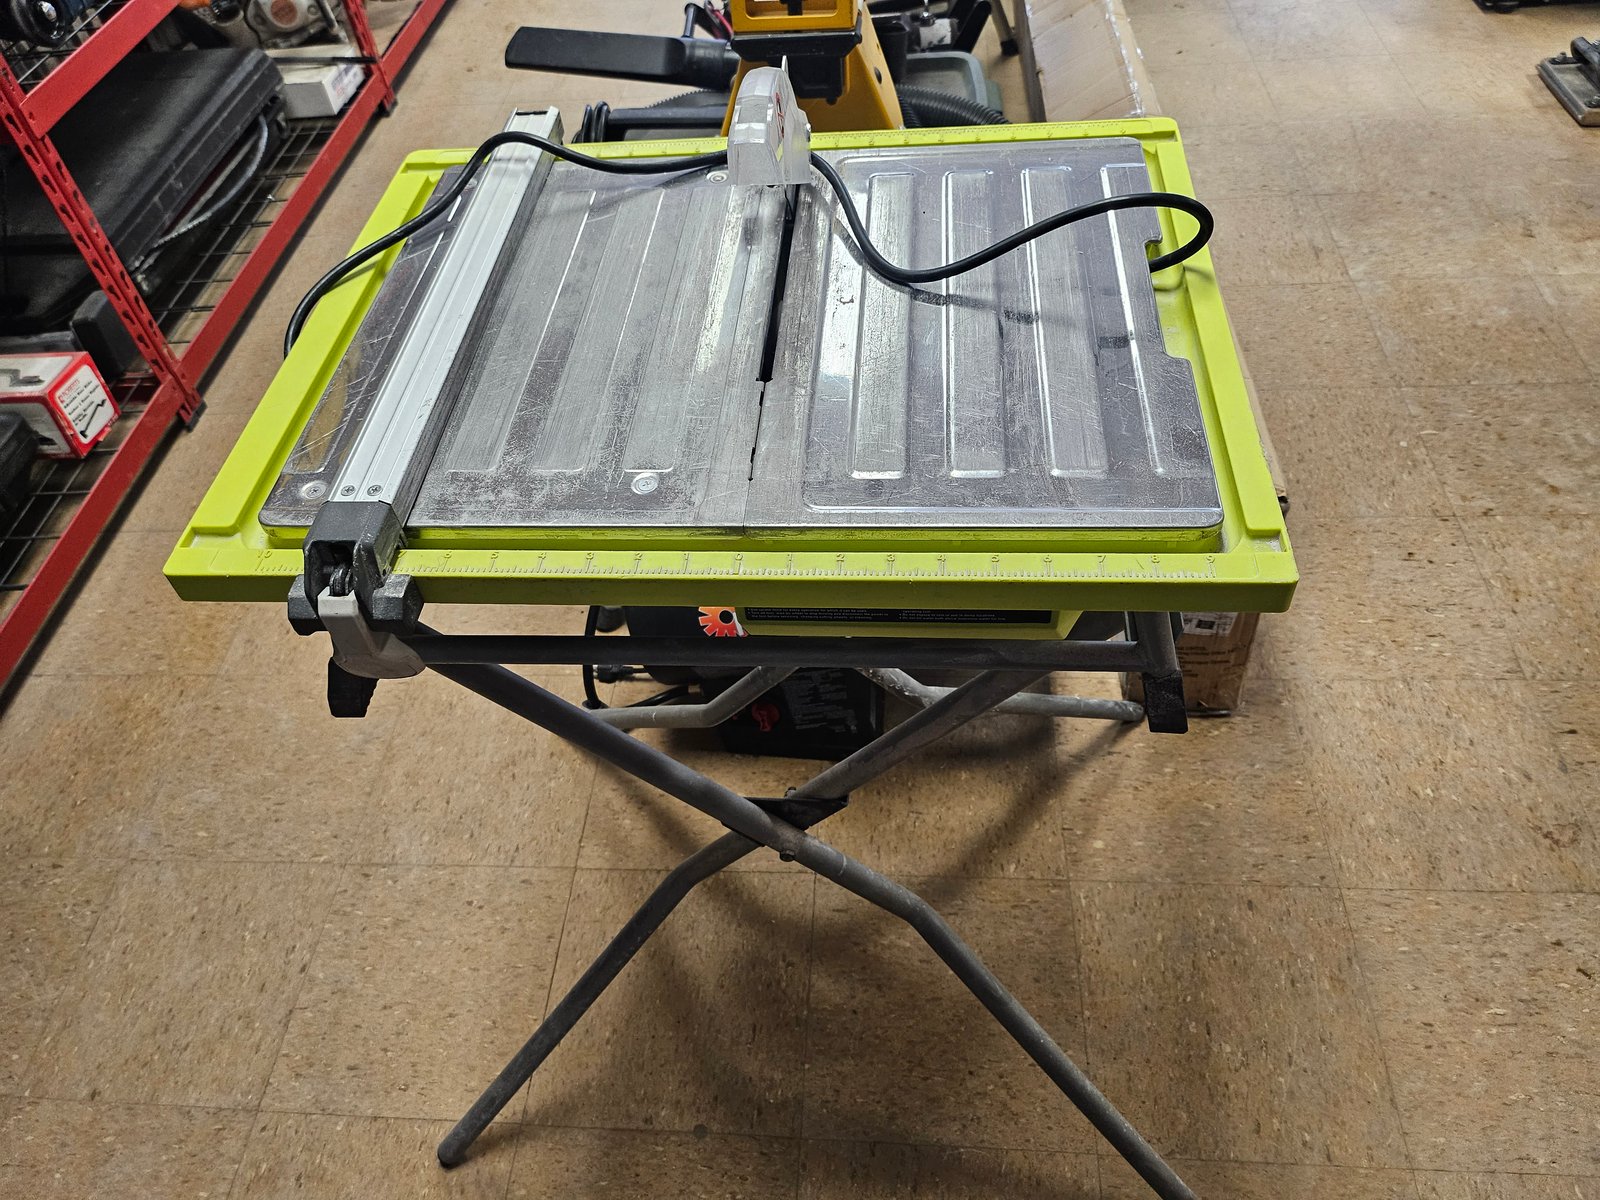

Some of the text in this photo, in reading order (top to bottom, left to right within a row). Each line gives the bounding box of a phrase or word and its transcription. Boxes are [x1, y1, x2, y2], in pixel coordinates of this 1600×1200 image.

[443, 551, 452, 559] 6
[490, 551, 500, 560] 5
[537, 551, 547, 560] 4
[585, 552, 595, 560] 3
[633, 552, 643, 561] 2
[684, 552, 690, 561] 1
[734, 553, 744, 561] 0
[836, 554, 846, 562] 2
[886, 554, 896, 562] 3
[937, 554, 947, 562] 4
[991, 554, 1001, 563] 5
[1043, 554, 1053, 563] 6
[1097, 555, 1106, 563] 7
[1150, 555, 1161, 564] 8
[1206, 555, 1216, 564] 9
